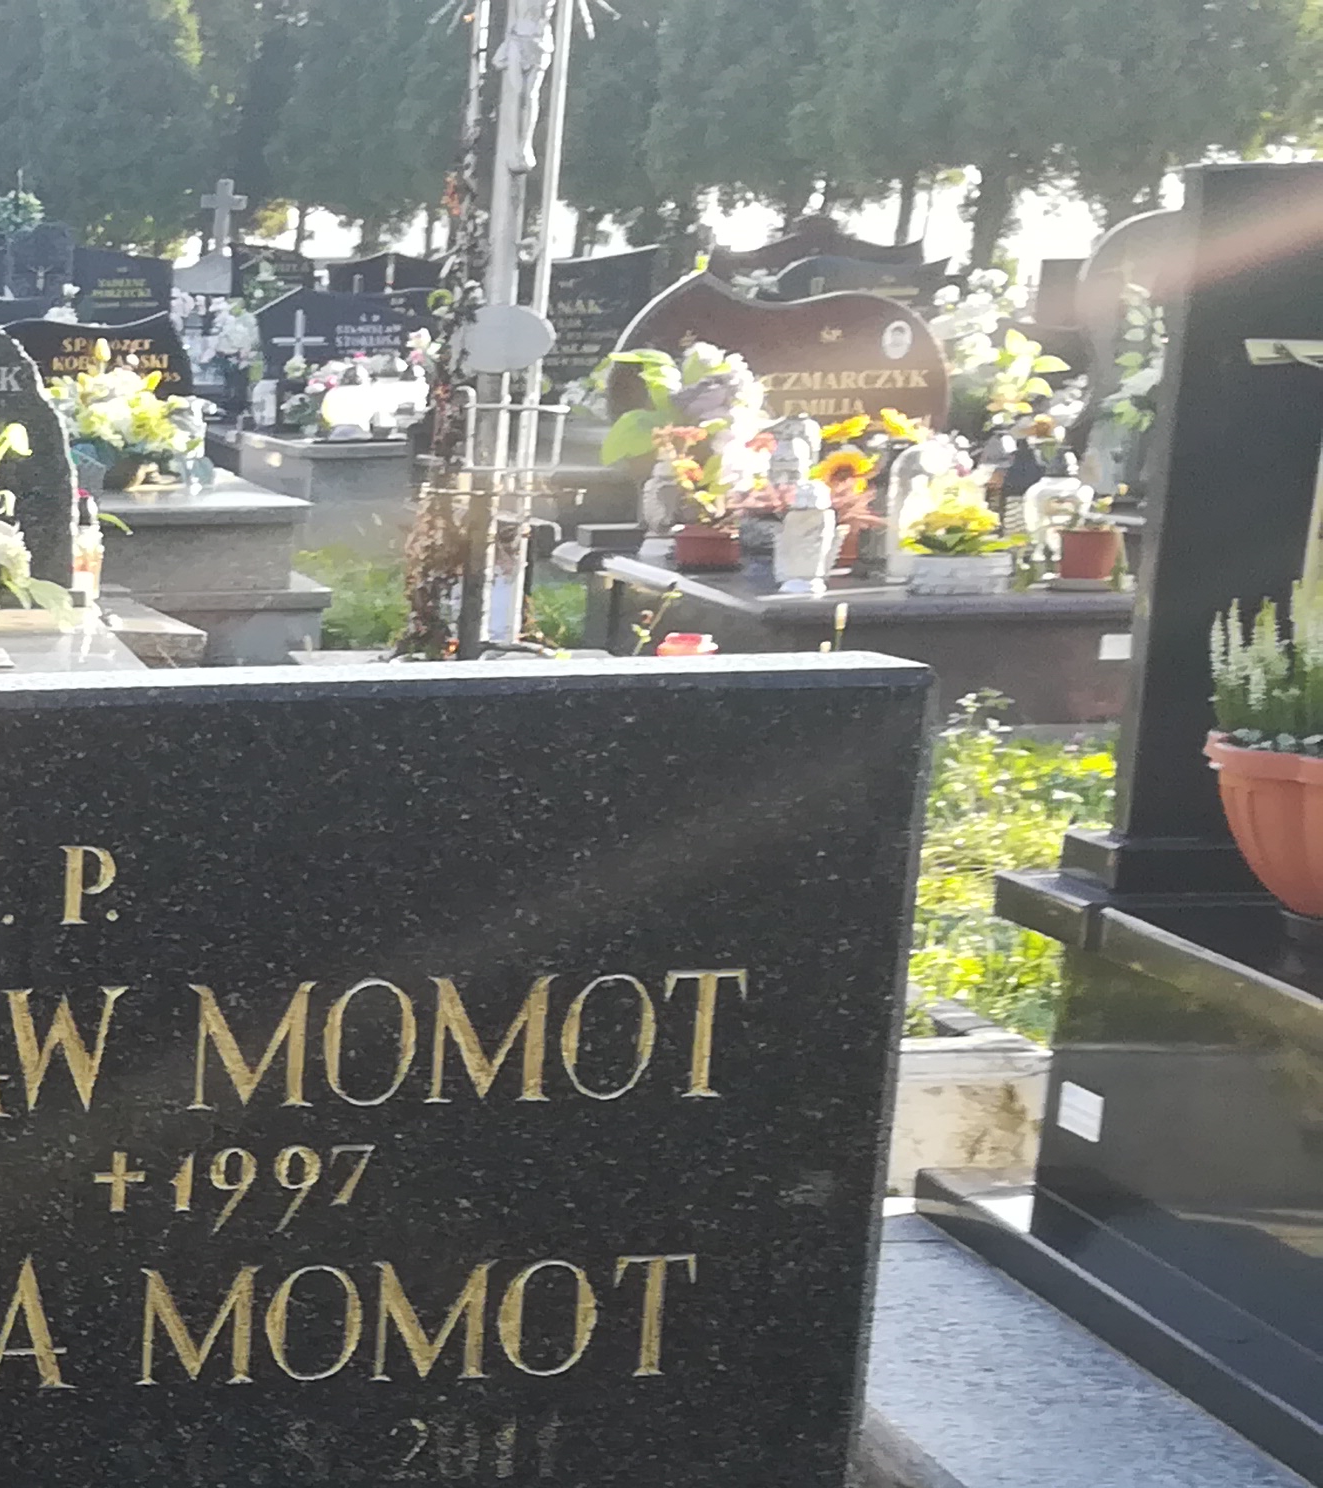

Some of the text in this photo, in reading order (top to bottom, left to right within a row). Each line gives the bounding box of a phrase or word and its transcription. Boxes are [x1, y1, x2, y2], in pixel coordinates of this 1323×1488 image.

[60, 844, 119, 926] P.
[185, 968, 749, 1111] MOMOT
[169, 1144, 376, 1235] 1997
[135, 1253, 697, 1386] MOMOT
